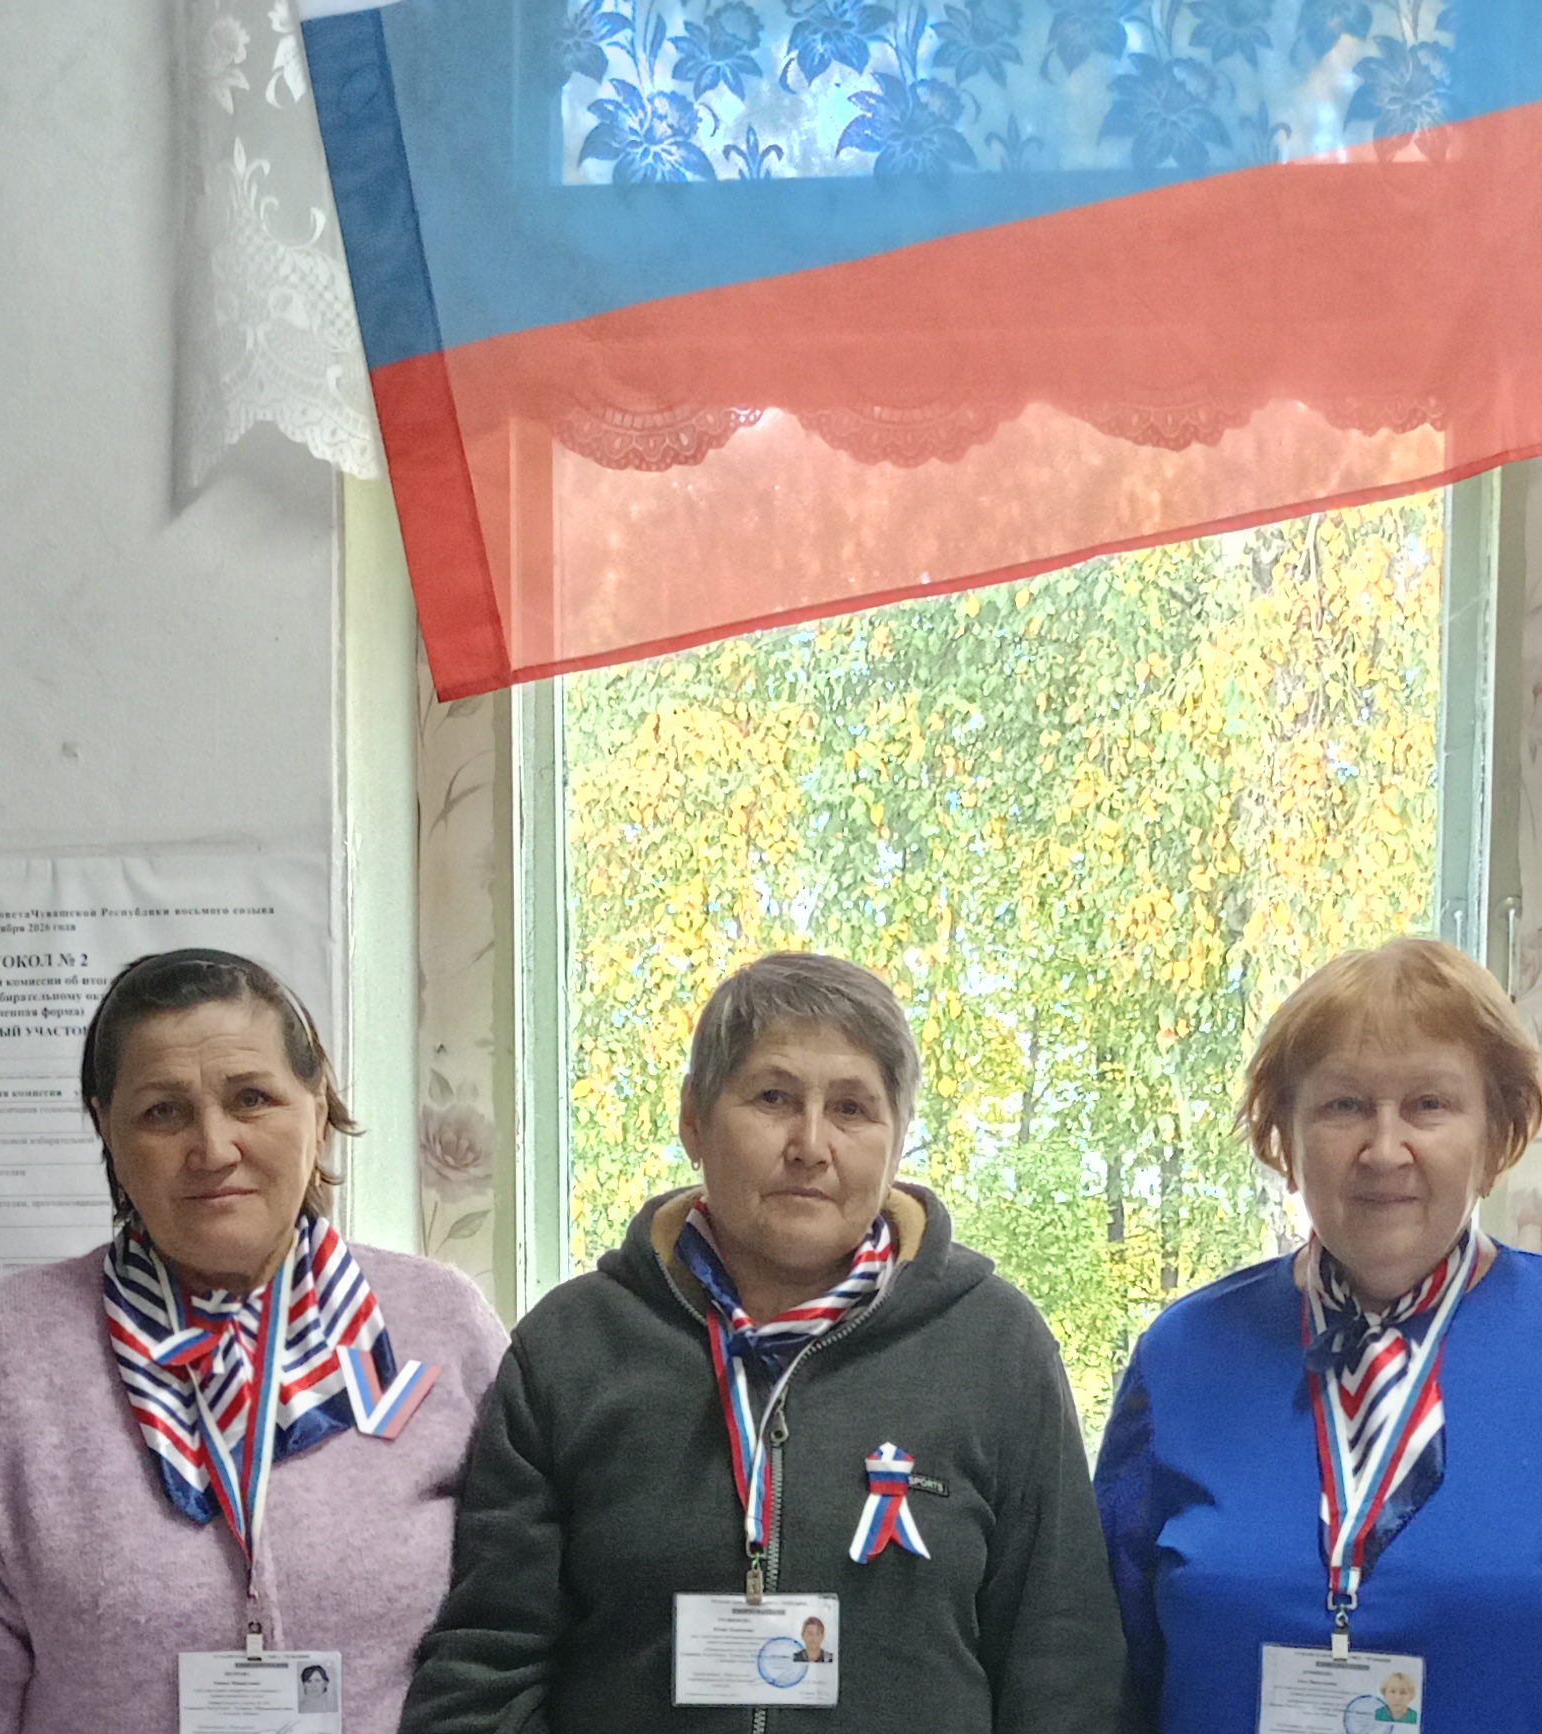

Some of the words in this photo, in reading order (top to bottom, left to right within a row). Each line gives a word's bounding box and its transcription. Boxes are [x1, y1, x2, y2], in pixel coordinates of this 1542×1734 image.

[101, 906, 169, 919] Республики
[174, 907, 229, 915] восьмого
[232, 906, 275, 915] созыва
[28, 922, 50, 933] 2026
[53, 923, 77, 932] года
[57, 952, 76, 968] №
[79, 951, 89, 968] 2
[6, 977, 62, 988] комиссии
[64, 974, 79, 986] об
[81, 976, 108, 986] итог
[41, 1006, 85, 1020] форма)
